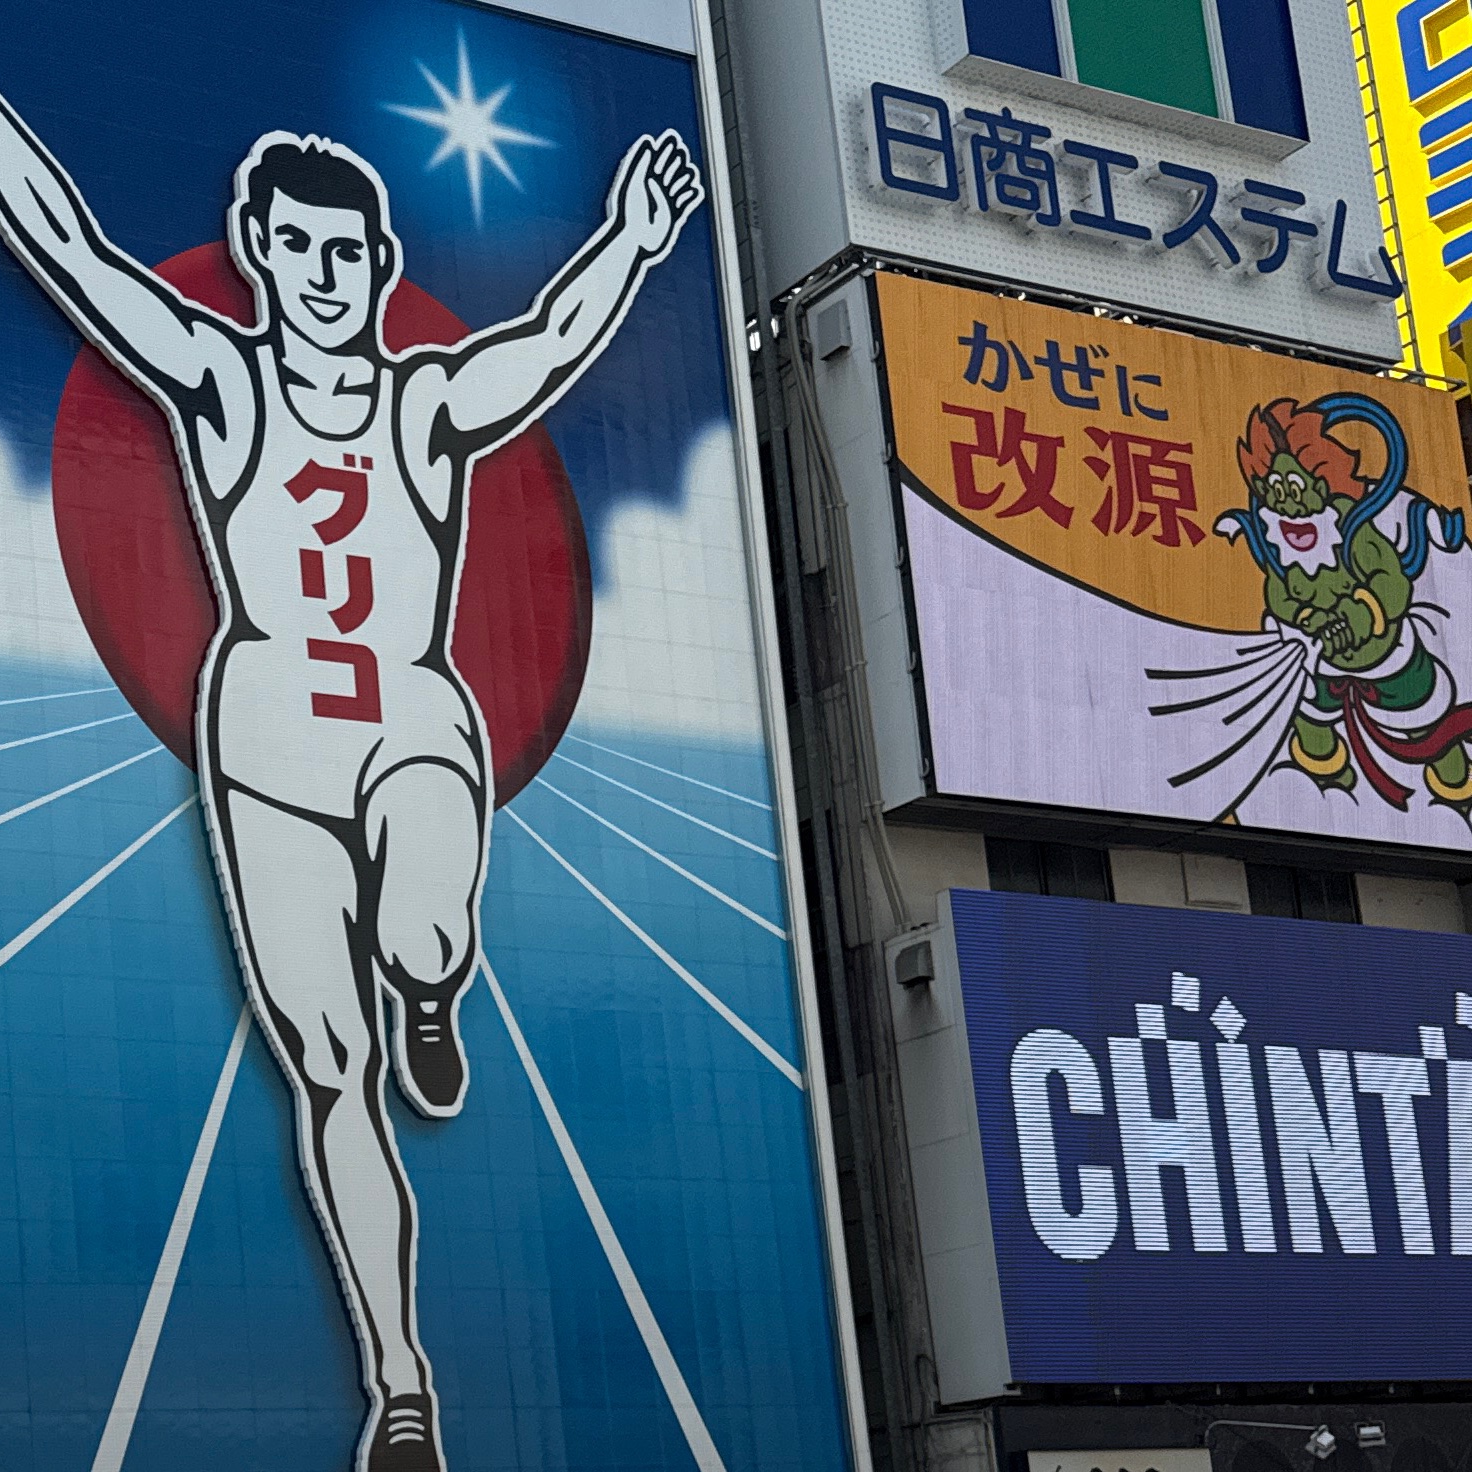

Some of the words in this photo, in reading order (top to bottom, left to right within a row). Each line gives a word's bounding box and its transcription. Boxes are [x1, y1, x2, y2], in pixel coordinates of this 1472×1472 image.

[870, 81, 1403, 299] 日商エステム
[957, 319, 1170, 422] かぜに
[940, 401, 1207, 548] 改源
[283, 453, 383, 724] グリコ
